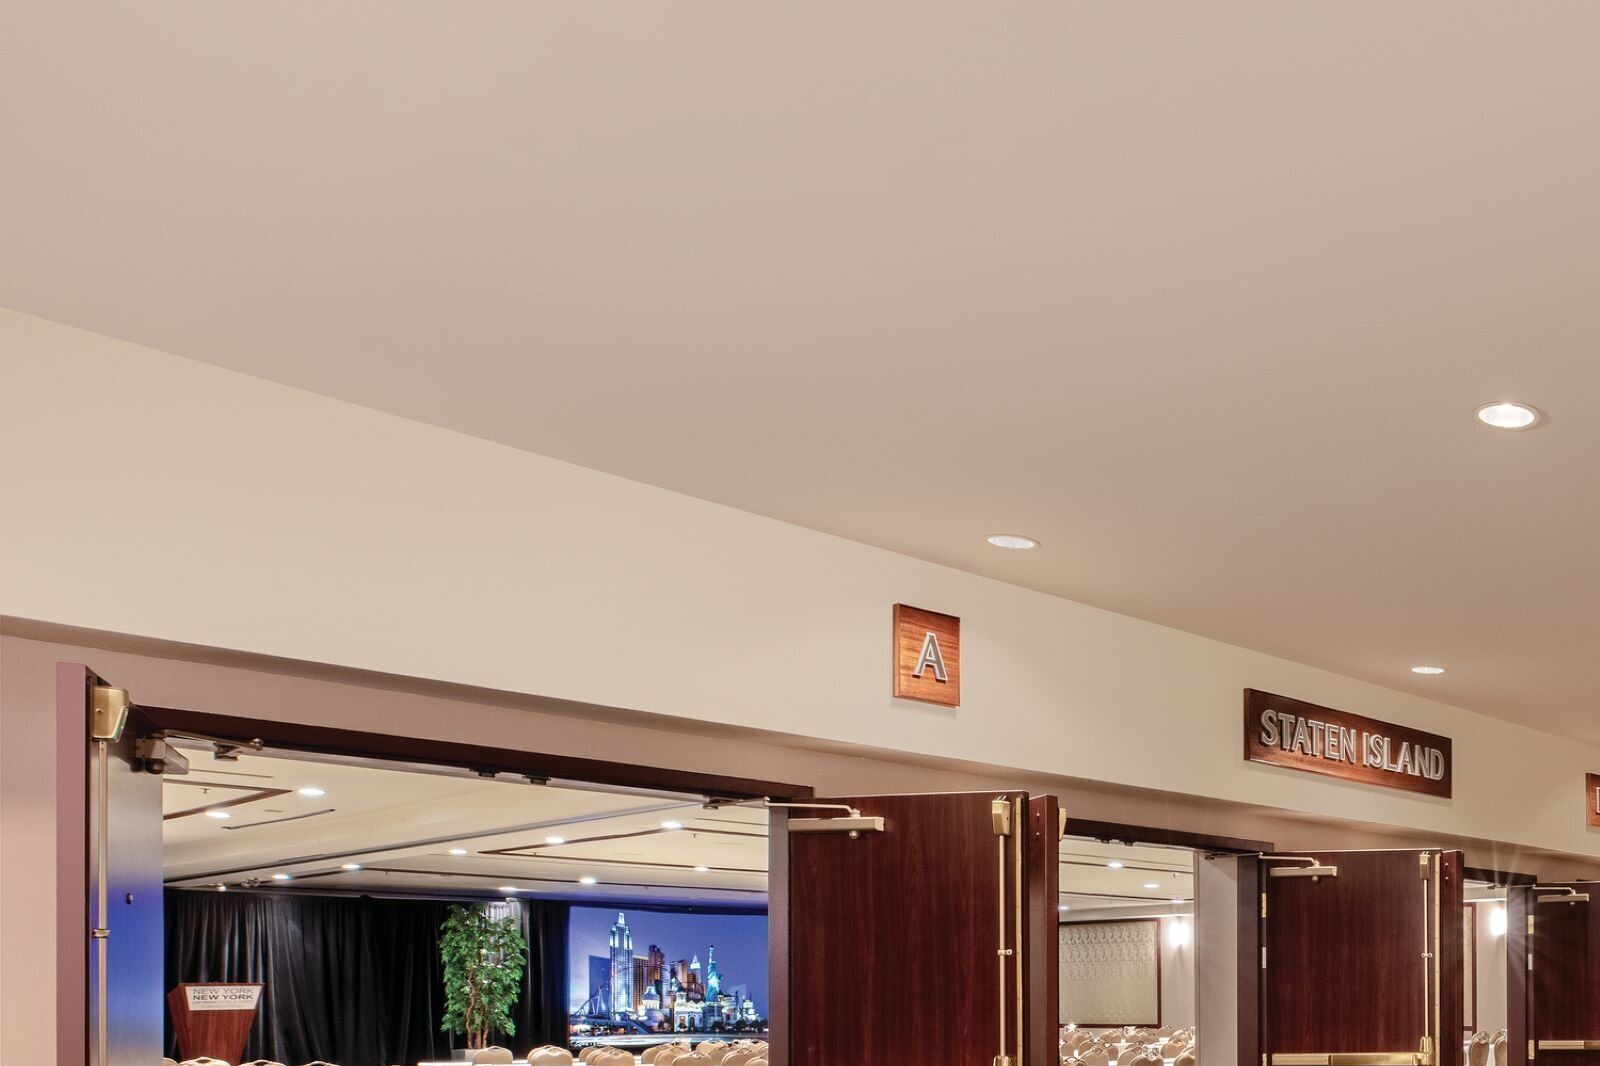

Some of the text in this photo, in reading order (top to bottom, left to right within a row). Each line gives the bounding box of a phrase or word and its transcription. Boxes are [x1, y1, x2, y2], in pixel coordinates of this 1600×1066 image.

[912, 631, 948, 681] A
[1260, 709, 1445, 780] STATEN ISLAND
